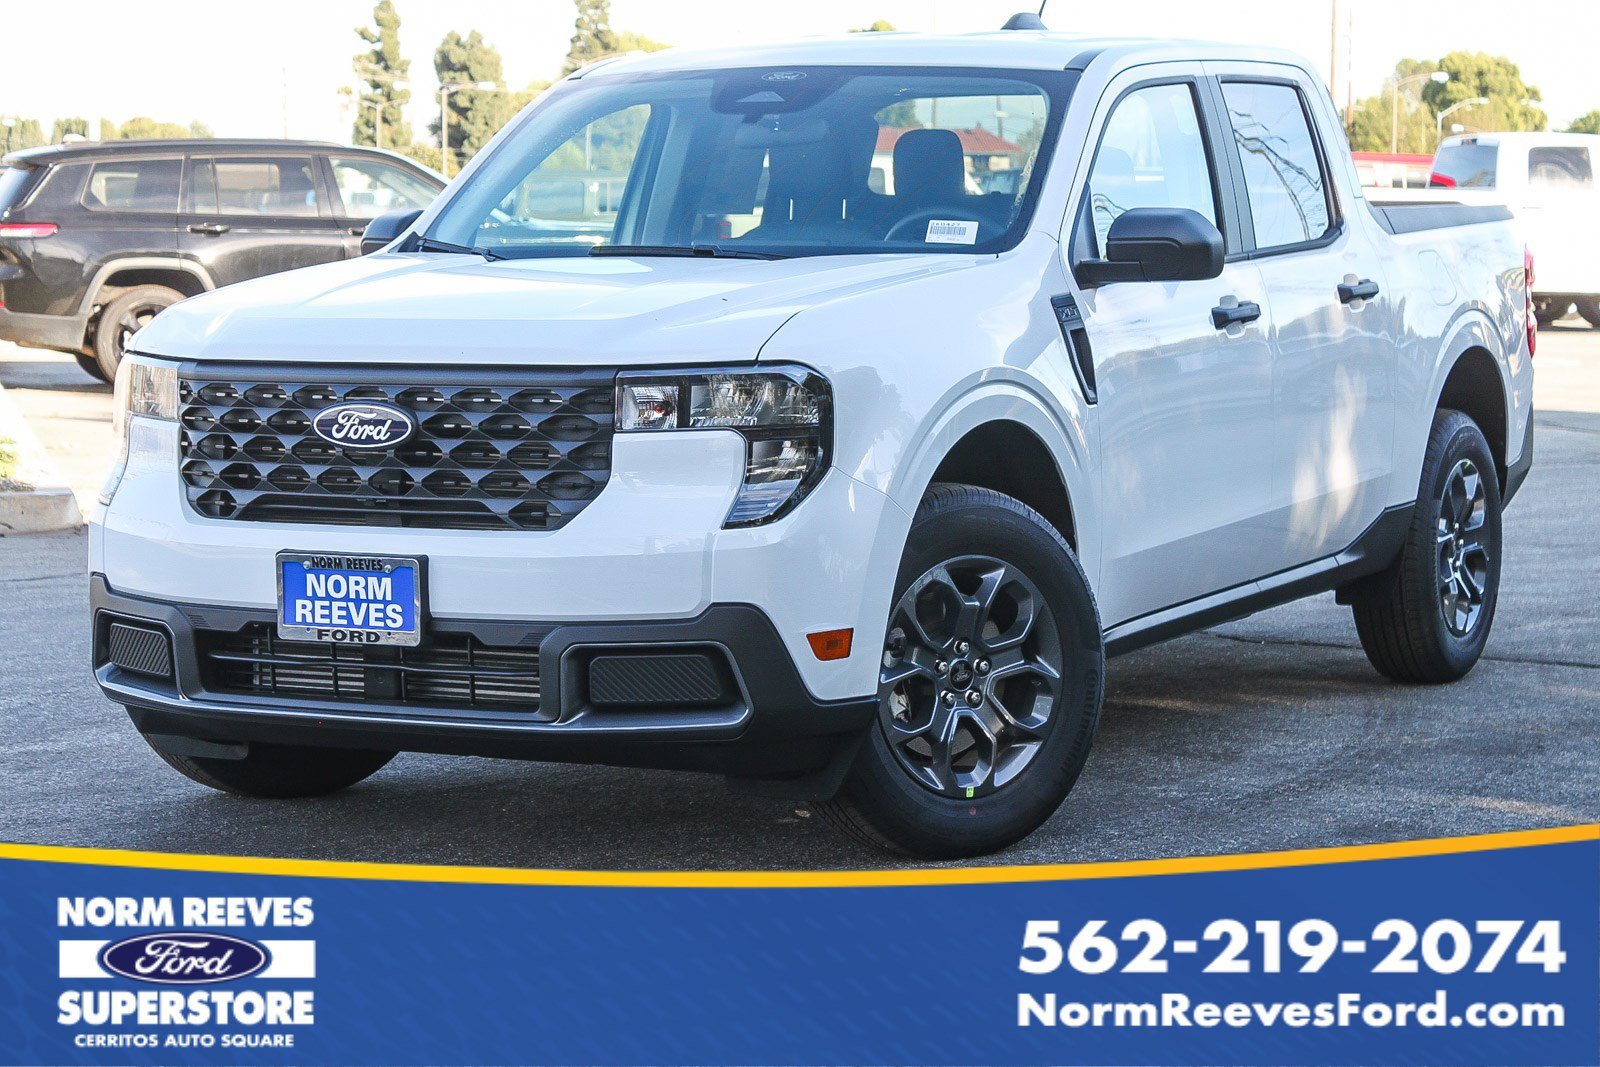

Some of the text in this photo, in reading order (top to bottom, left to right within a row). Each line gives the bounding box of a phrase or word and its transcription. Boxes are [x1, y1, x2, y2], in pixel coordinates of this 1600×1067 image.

[1058, 307, 1077, 319] XLT
[331, 410, 392, 441] Ford
[311, 556, 383, 571] NORM REEVES
[306, 573, 392, 601] NORM
[295, 599, 403, 629] REEVES
[317, 629, 381, 643] FORD
